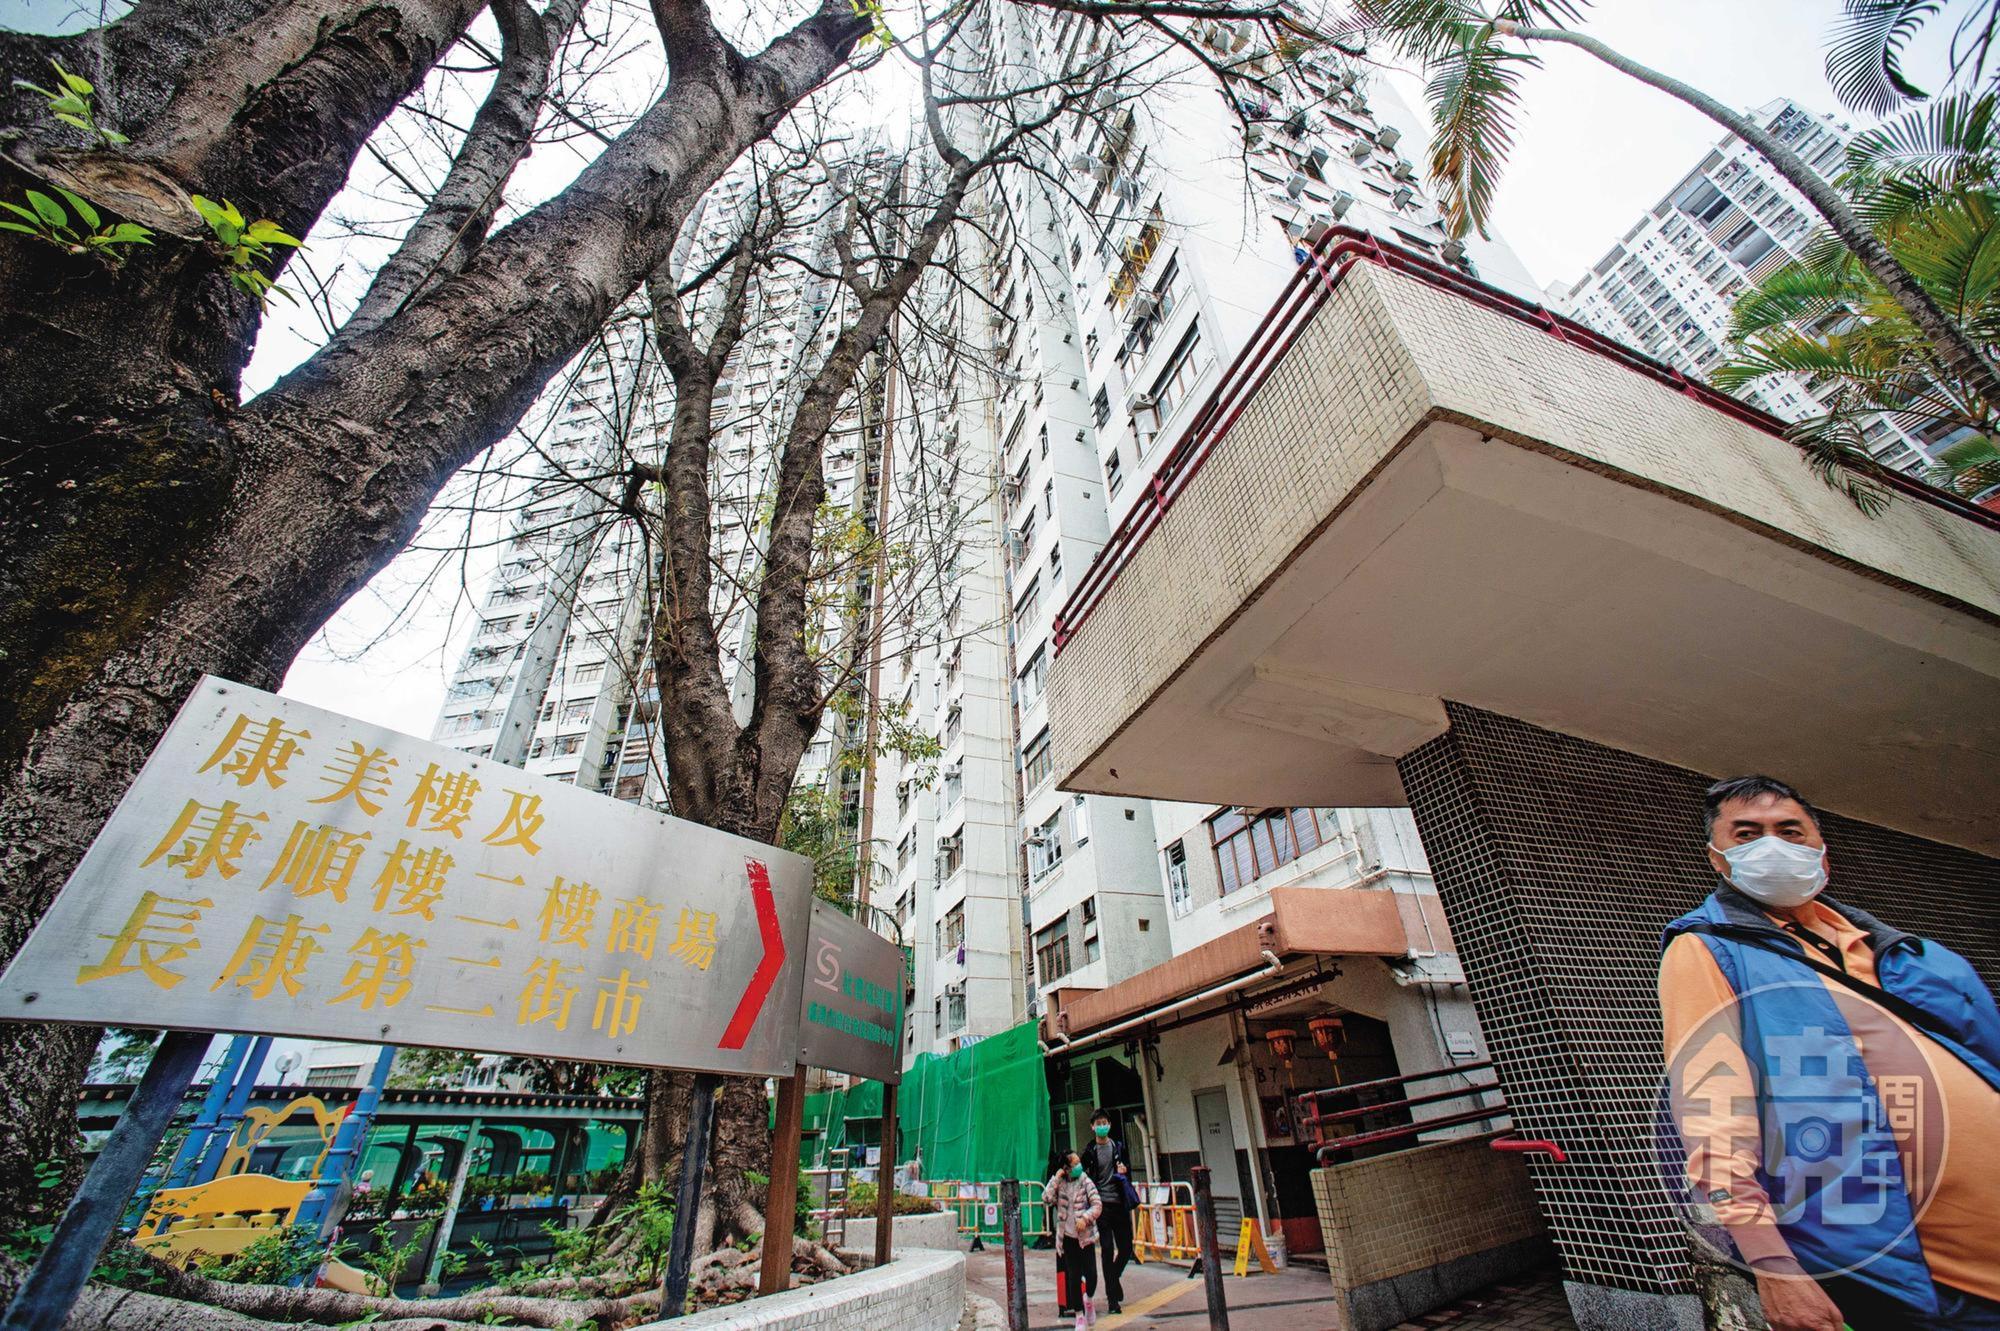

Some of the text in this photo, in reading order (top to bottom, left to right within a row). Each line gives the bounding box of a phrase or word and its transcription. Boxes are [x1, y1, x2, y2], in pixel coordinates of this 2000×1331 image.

[197, 713, 546, 857] 康美樓及
[139, 798, 719, 971] 康順樓二樓商場
[76, 890, 650, 1038] 長康第二街市
